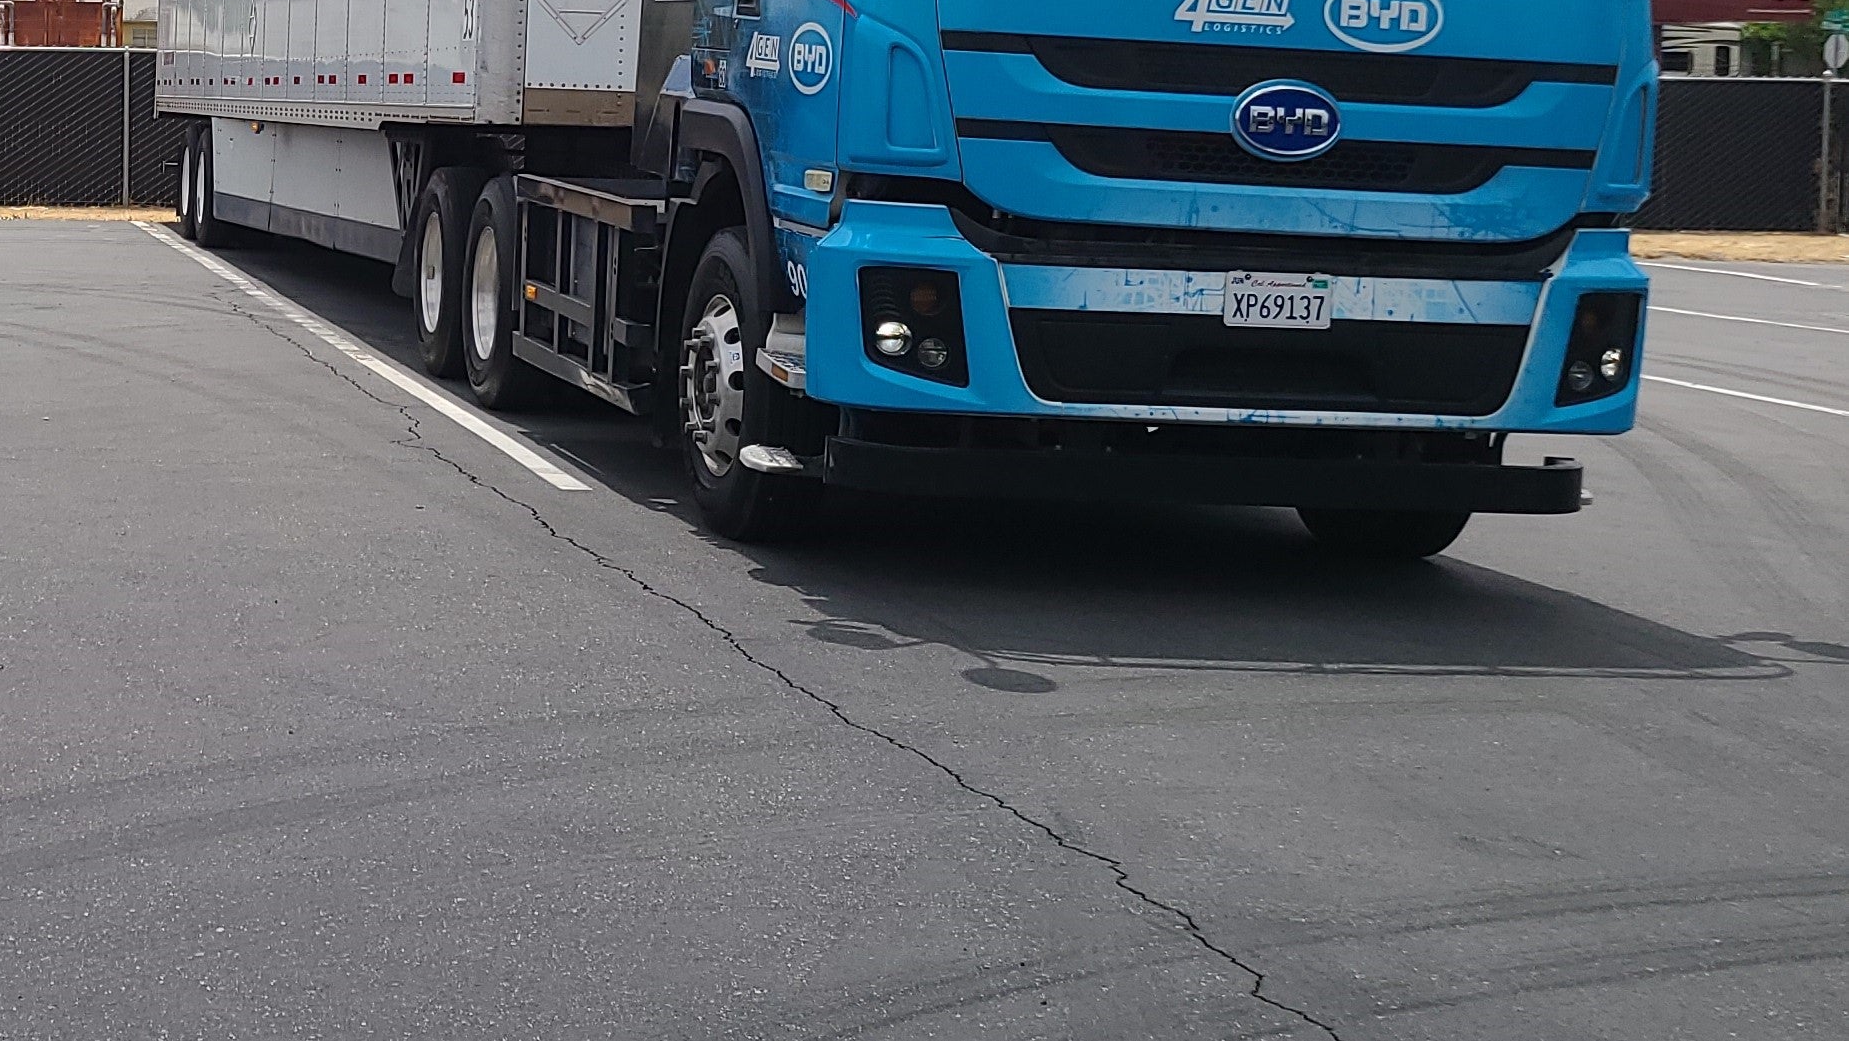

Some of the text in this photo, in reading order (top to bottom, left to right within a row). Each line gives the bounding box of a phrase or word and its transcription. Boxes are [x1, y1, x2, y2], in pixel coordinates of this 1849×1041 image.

[1204, 23, 1284, 35] LOGISTICS
[793, 43, 827, 74] BYD
[1249, 105, 1329, 136] BYD
[1232, 292, 1325, 321] XP69137
